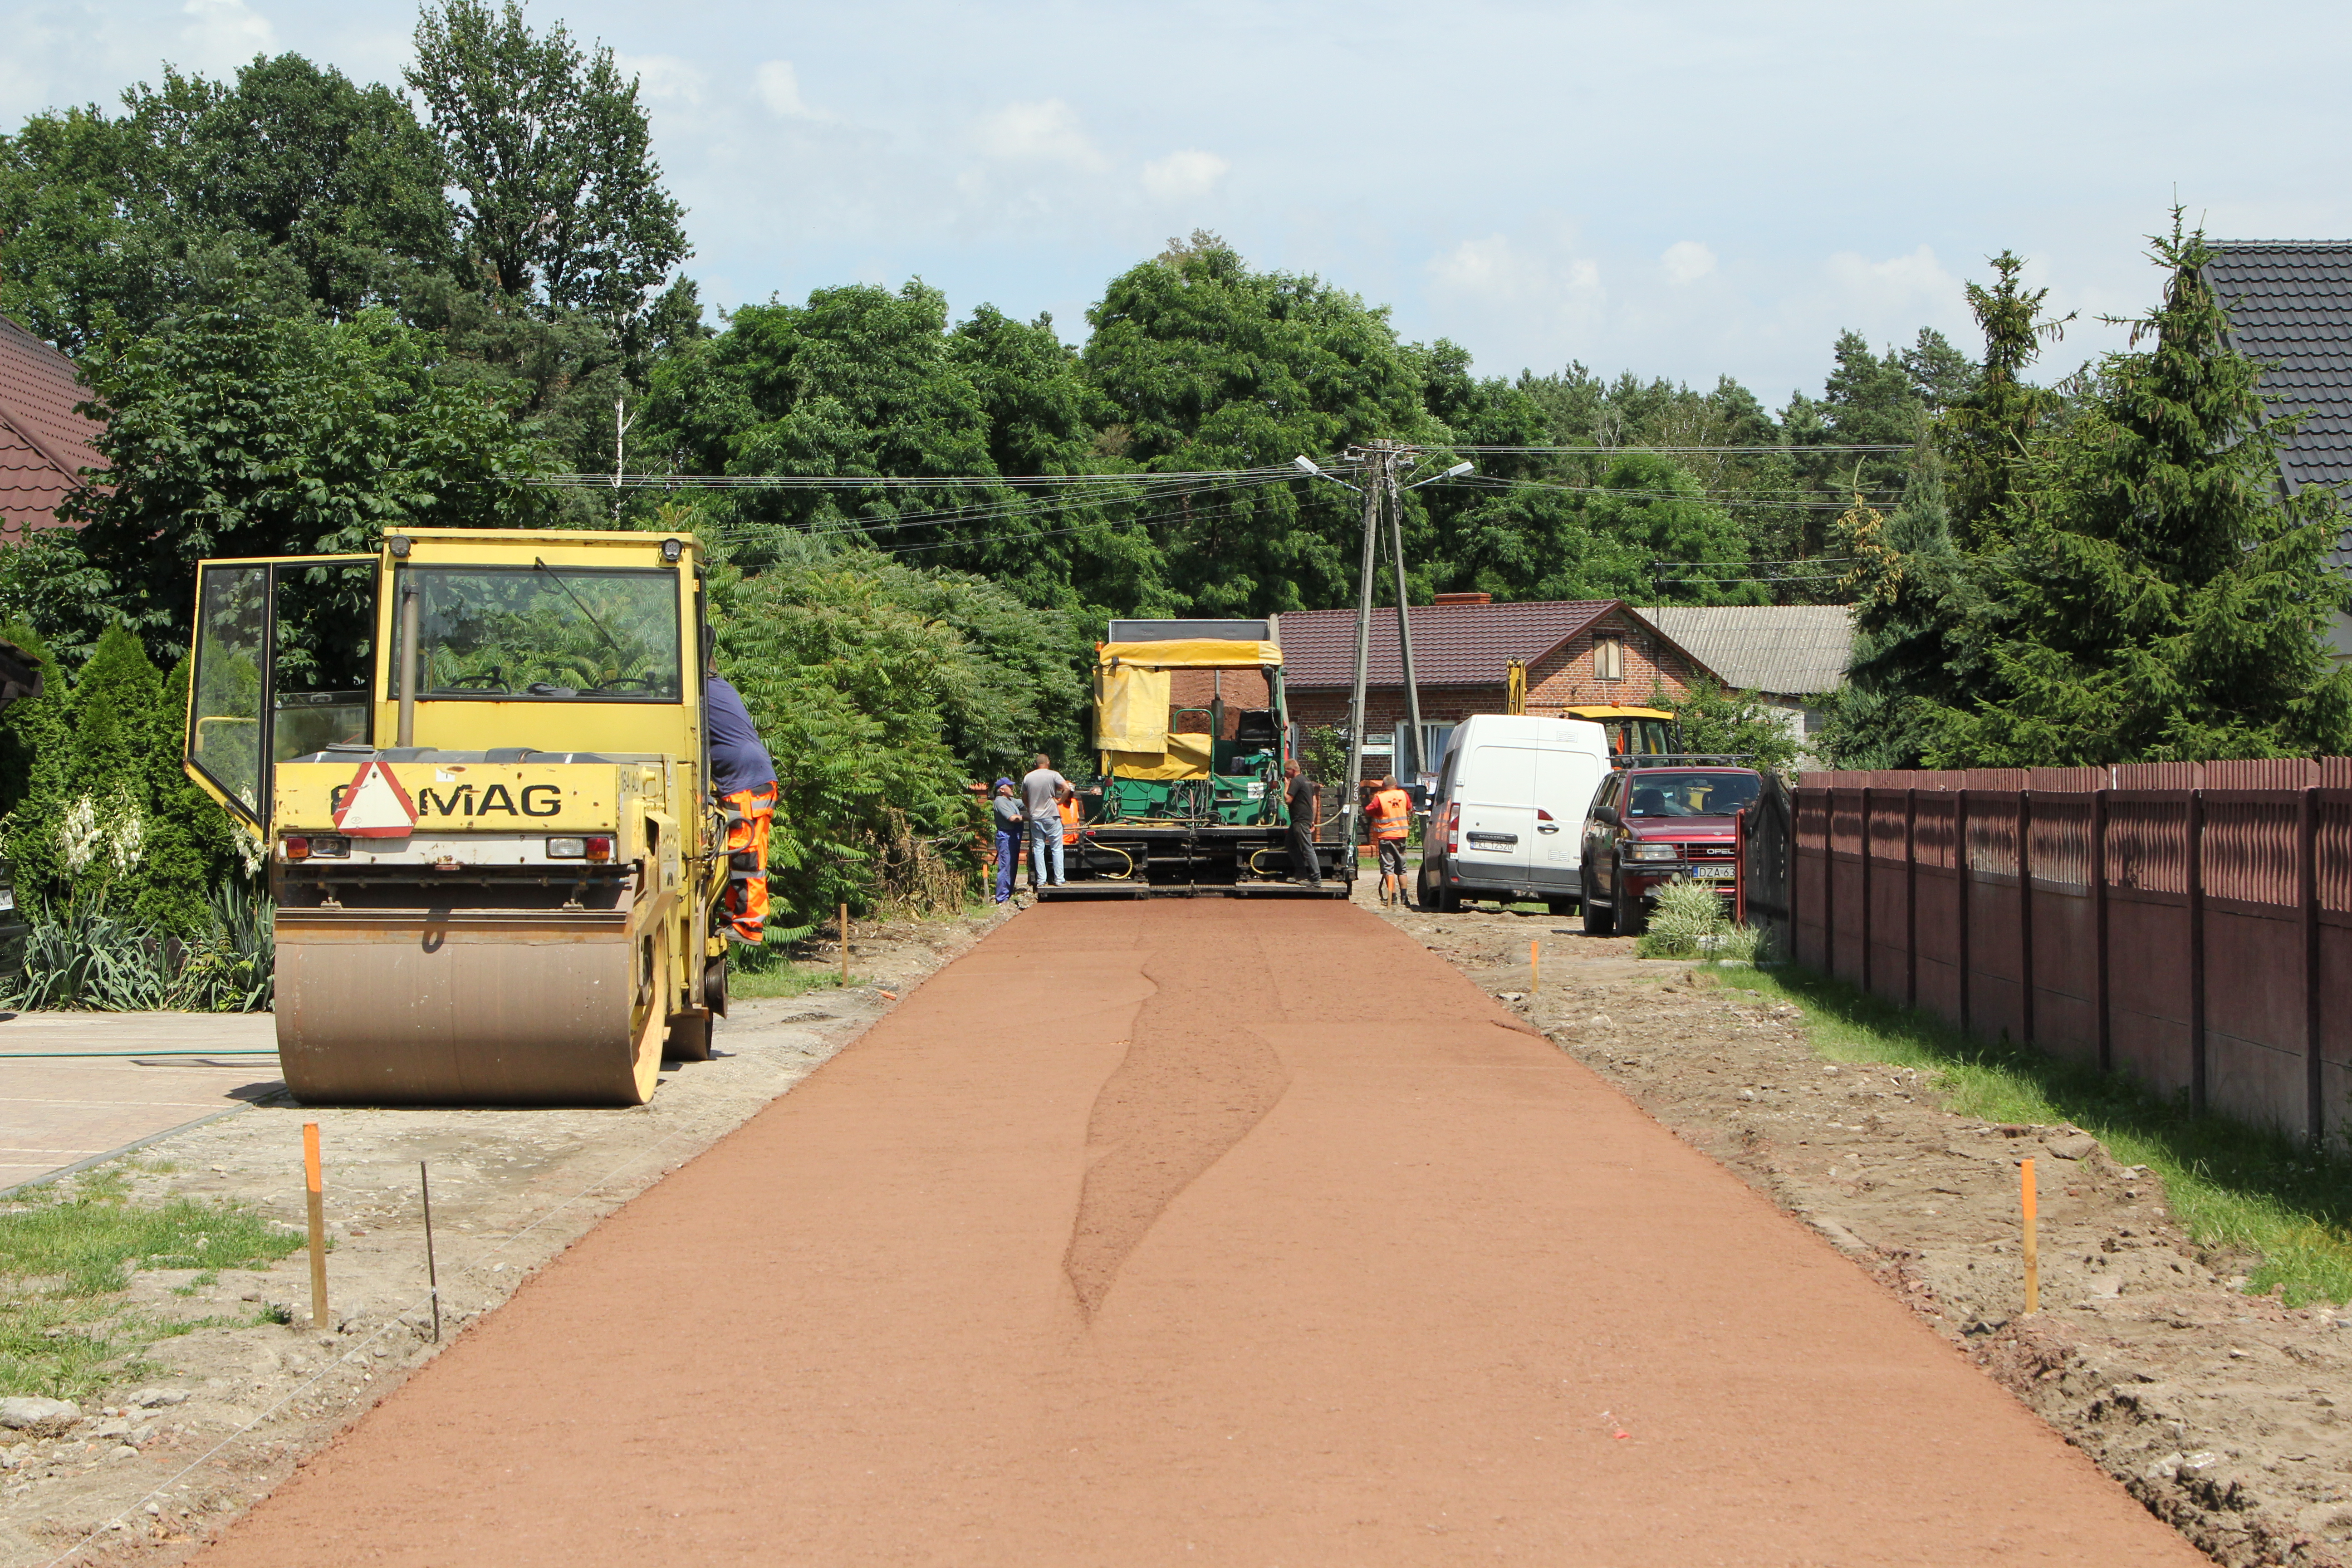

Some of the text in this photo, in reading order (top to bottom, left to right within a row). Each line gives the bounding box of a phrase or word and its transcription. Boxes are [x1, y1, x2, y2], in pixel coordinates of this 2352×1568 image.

[331, 784, 561, 816] MAG
[1474, 840, 1513, 851] PKL 12520
[1700, 867, 1720, 877] DZA
